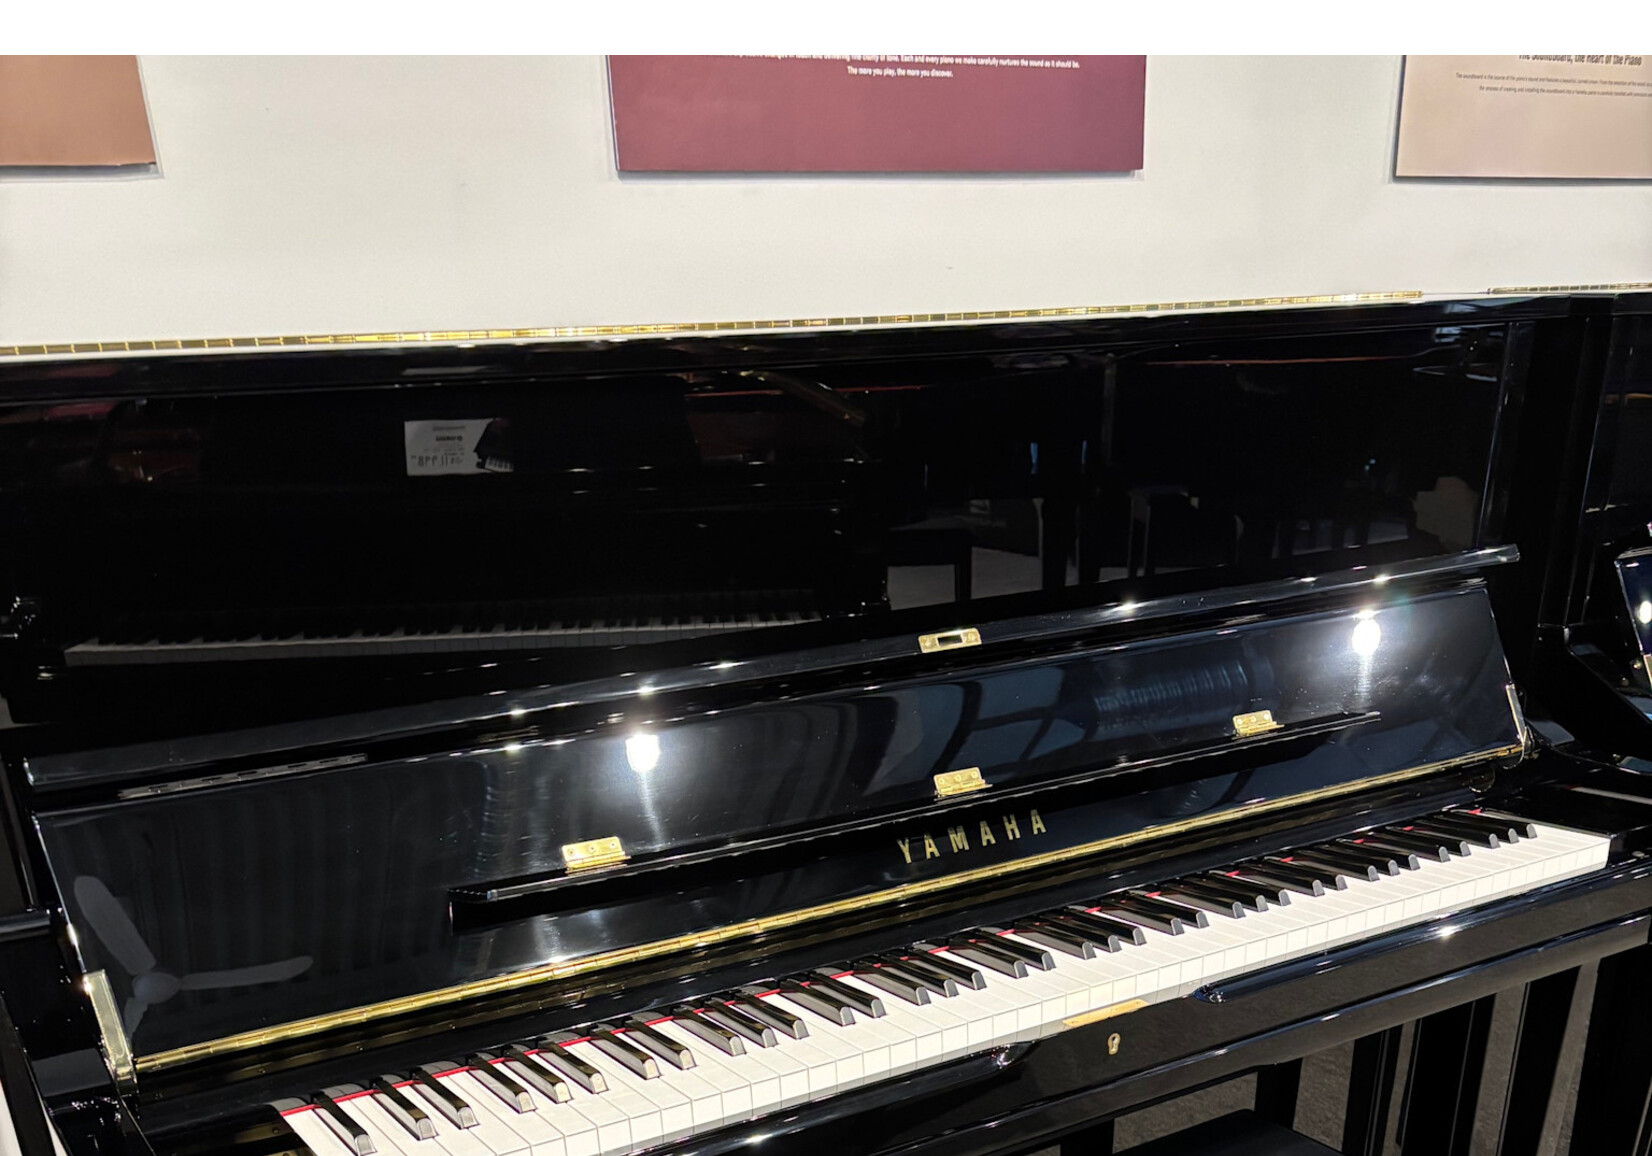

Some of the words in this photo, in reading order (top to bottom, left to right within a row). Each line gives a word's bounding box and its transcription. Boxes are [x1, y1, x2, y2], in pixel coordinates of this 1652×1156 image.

[915, 55, 925, 63] and
[925, 57, 939, 65] every
[940, 56, 954, 65] piano
[963, 57, 977, 65] make
[977, 57, 998, 67] carefully
[999, 59, 1020, 67] nurtures
[1020, 58, 1029, 67] the
[1029, 59, 1044, 68] sound
[1056, 60, 1072, 68] should
[1072, 60, 1080, 68] be.
[1604, 55, 1612, 64] of
[1612, 55, 1623, 65] the
[1623, 55, 1642, 66] Piano
[847, 65, 858, 75] The
[858, 67, 872, 75] more
[872, 68, 882, 77] you
[883, 67, 896, 77] play,
[896, 67, 906, 76] the
[906, 68, 920, 76] more
[920, 69, 930, 78] you
[930, 68, 953, 78] discover.
[897, 809, 1047, 864] YAMAHA
